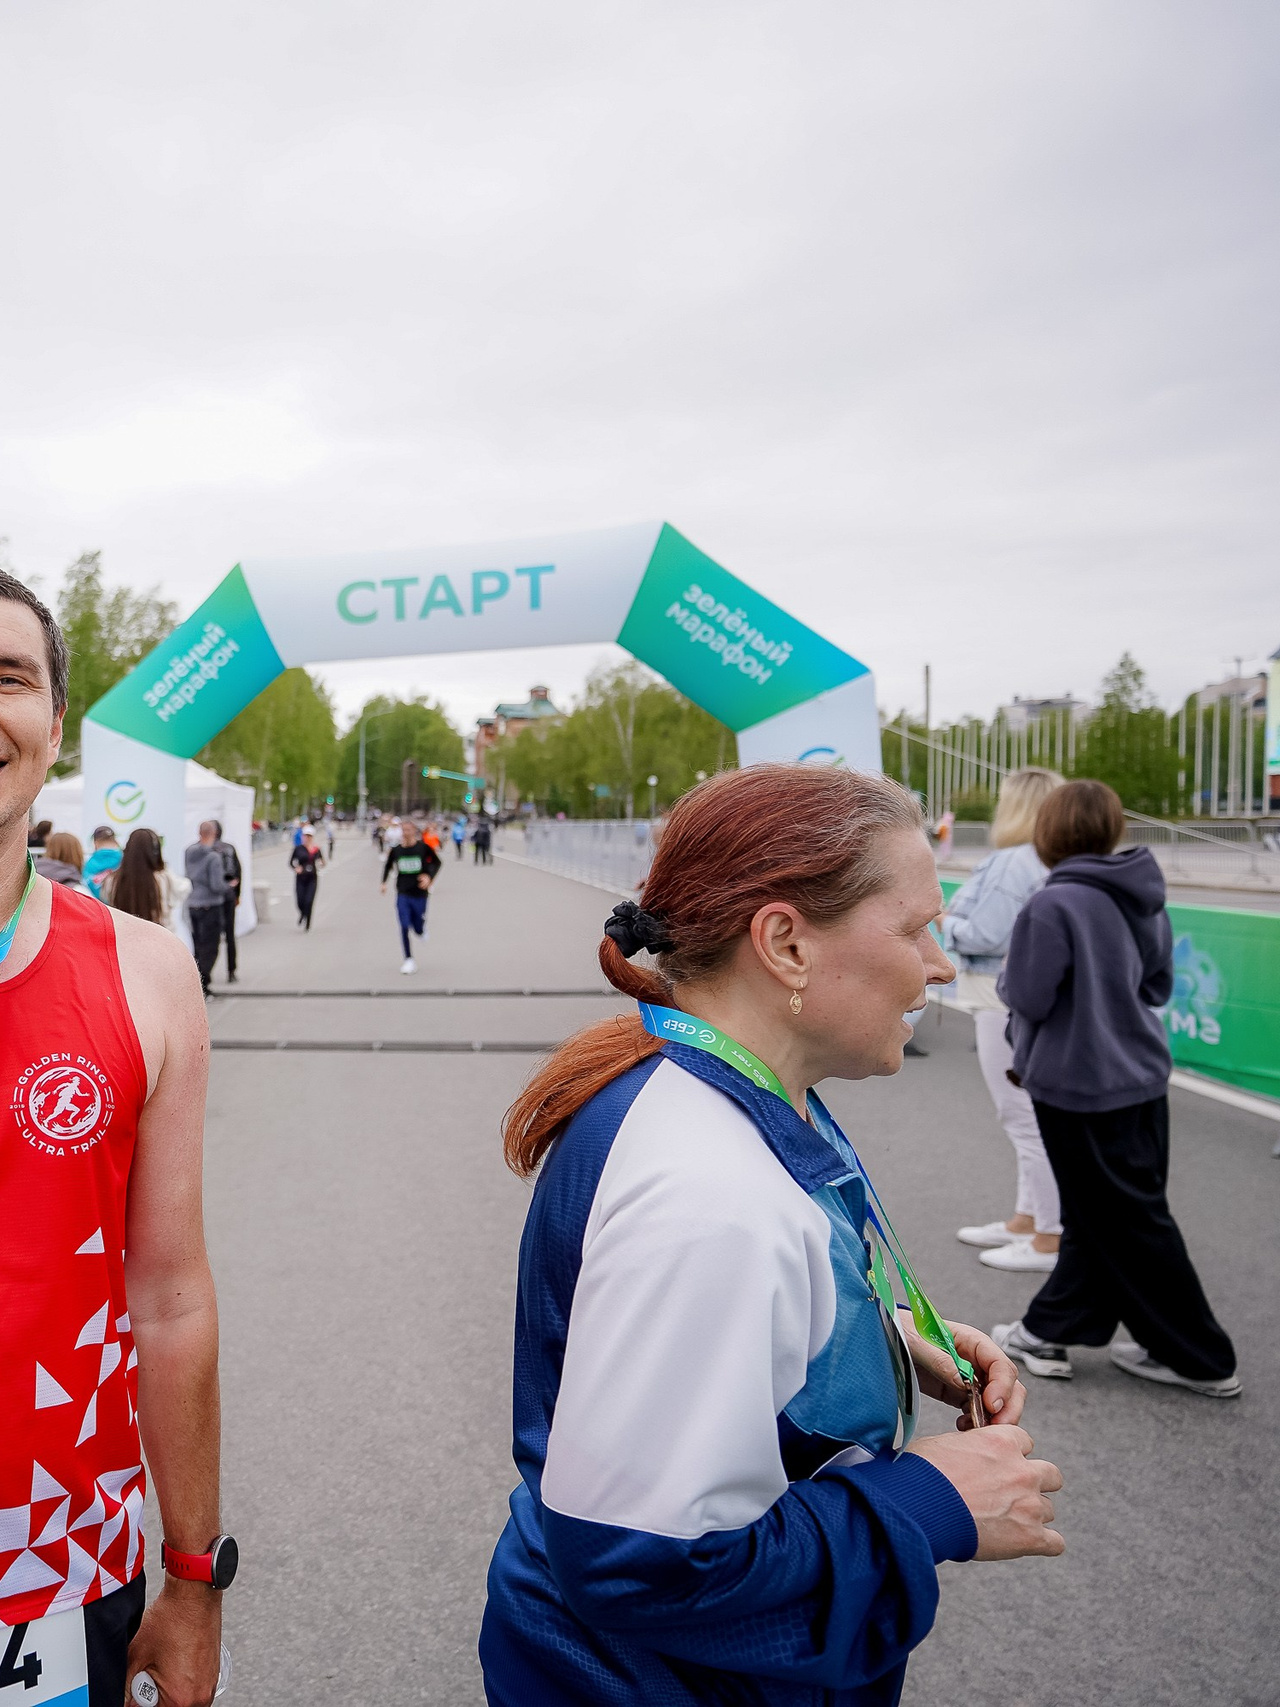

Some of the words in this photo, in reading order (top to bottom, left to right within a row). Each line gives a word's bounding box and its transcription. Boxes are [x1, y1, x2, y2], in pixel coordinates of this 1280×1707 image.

[336, 565, 555, 625] СТАРТ
[682, 584, 793, 666] зелёный
[143, 622, 226, 707] зелёный
[665, 602, 772, 685] марафон
[156, 638, 240, 722] марафон
[662, 1019, 697, 1035] СБЕР
[18, 1053, 70, 1085] GOLDEN
[76, 1055, 107, 1084] RING
[22, 1128, 65, 1156] ULTRA
[71, 1129, 106, 1154] TRAIL
